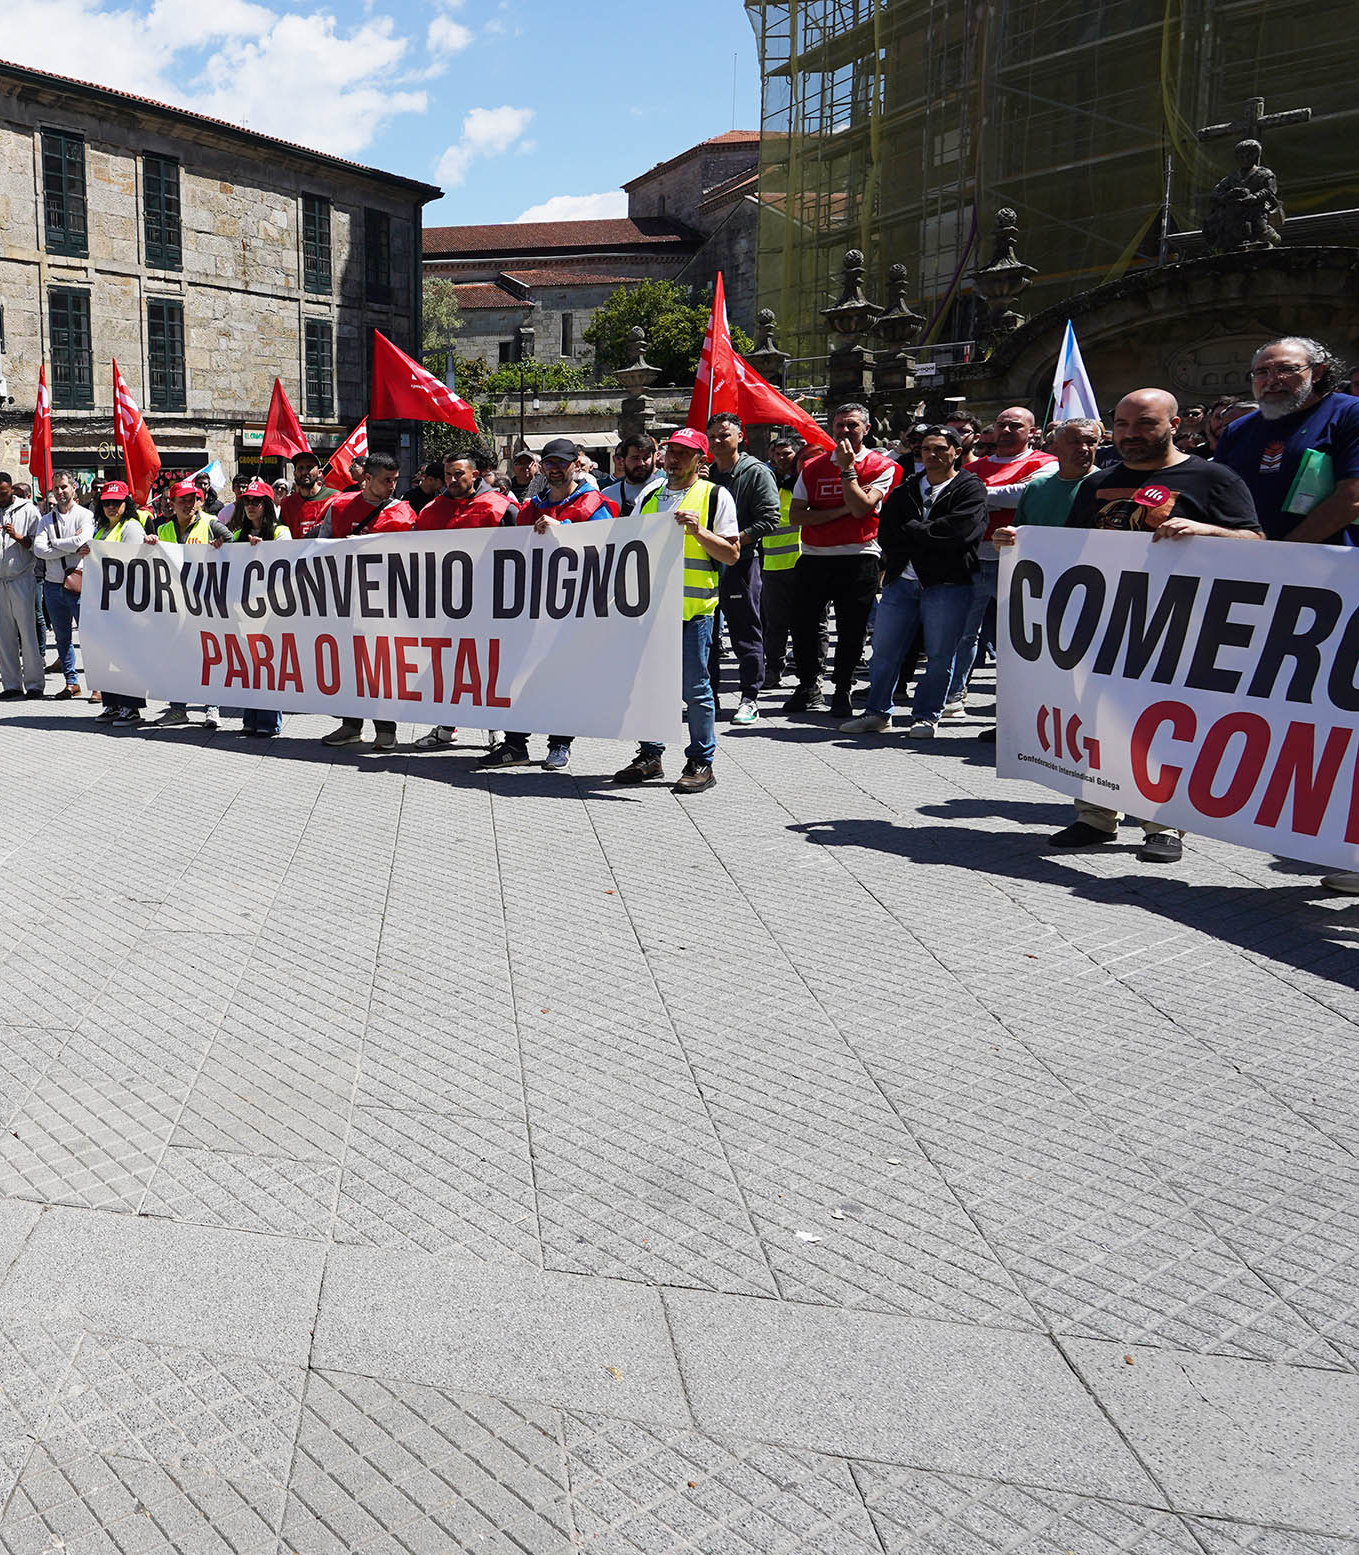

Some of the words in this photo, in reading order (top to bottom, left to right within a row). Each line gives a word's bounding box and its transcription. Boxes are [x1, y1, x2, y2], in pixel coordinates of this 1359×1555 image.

[100, 557, 177, 613] POR
[178, 560, 230, 618] UN
[241, 551, 474, 620] CONVENIO
[493, 539, 651, 620] DIGNO
[201, 630, 304, 693] PARA
[314, 633, 342, 697] O
[353, 635, 511, 708] METAL
[1017, 753, 1058, 772] Confederación
[1058, 765, 1095, 784] Intersindical
[1096, 777, 1120, 791] Galega
[1036, 704, 1101, 770] CIG
[1130, 700, 1359, 845] CON
